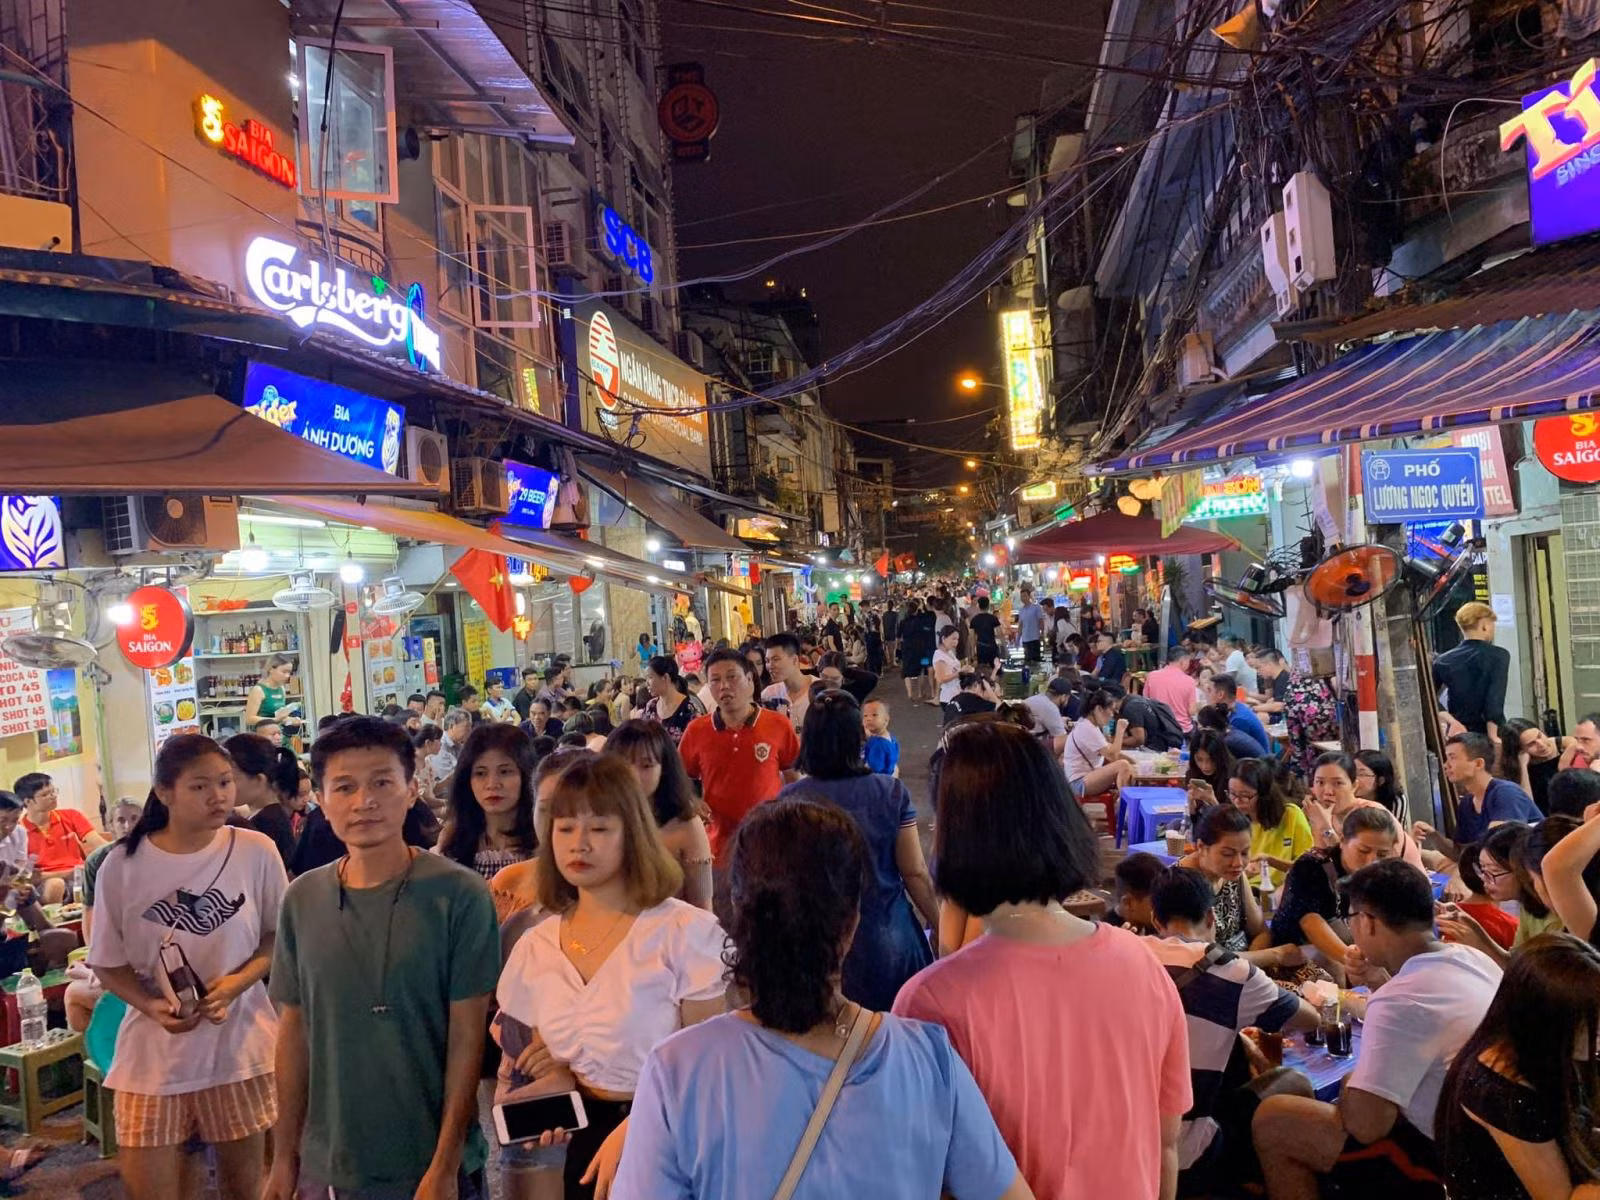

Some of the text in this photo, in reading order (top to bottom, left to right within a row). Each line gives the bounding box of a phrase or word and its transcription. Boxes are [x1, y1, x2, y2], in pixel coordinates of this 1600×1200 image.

[249, 119, 273, 150] BIA
[223, 122, 297, 188] SAIGON
[603, 206, 654, 284] SCB
[246, 236, 409, 342] Carlsberg
[333, 404, 350, 422] BIA
[302, 421, 330, 449] ÁNH
[1575, 440, 1597, 450] BIA
[1404, 457, 1441, 477] PHỐ
[528, 489, 546, 505] BEER
[1373, 484, 1409, 511] LƯƠNG
[1410, 484, 1439, 513] NGỌC
[128, 641, 173, 653] SAIGON
[22, 682, 40, 692] 45
[27, 693, 42, 703] 40
[2, 706, 45, 721] SHOT 45
[1, 719, 47, 735] SHOT 30
